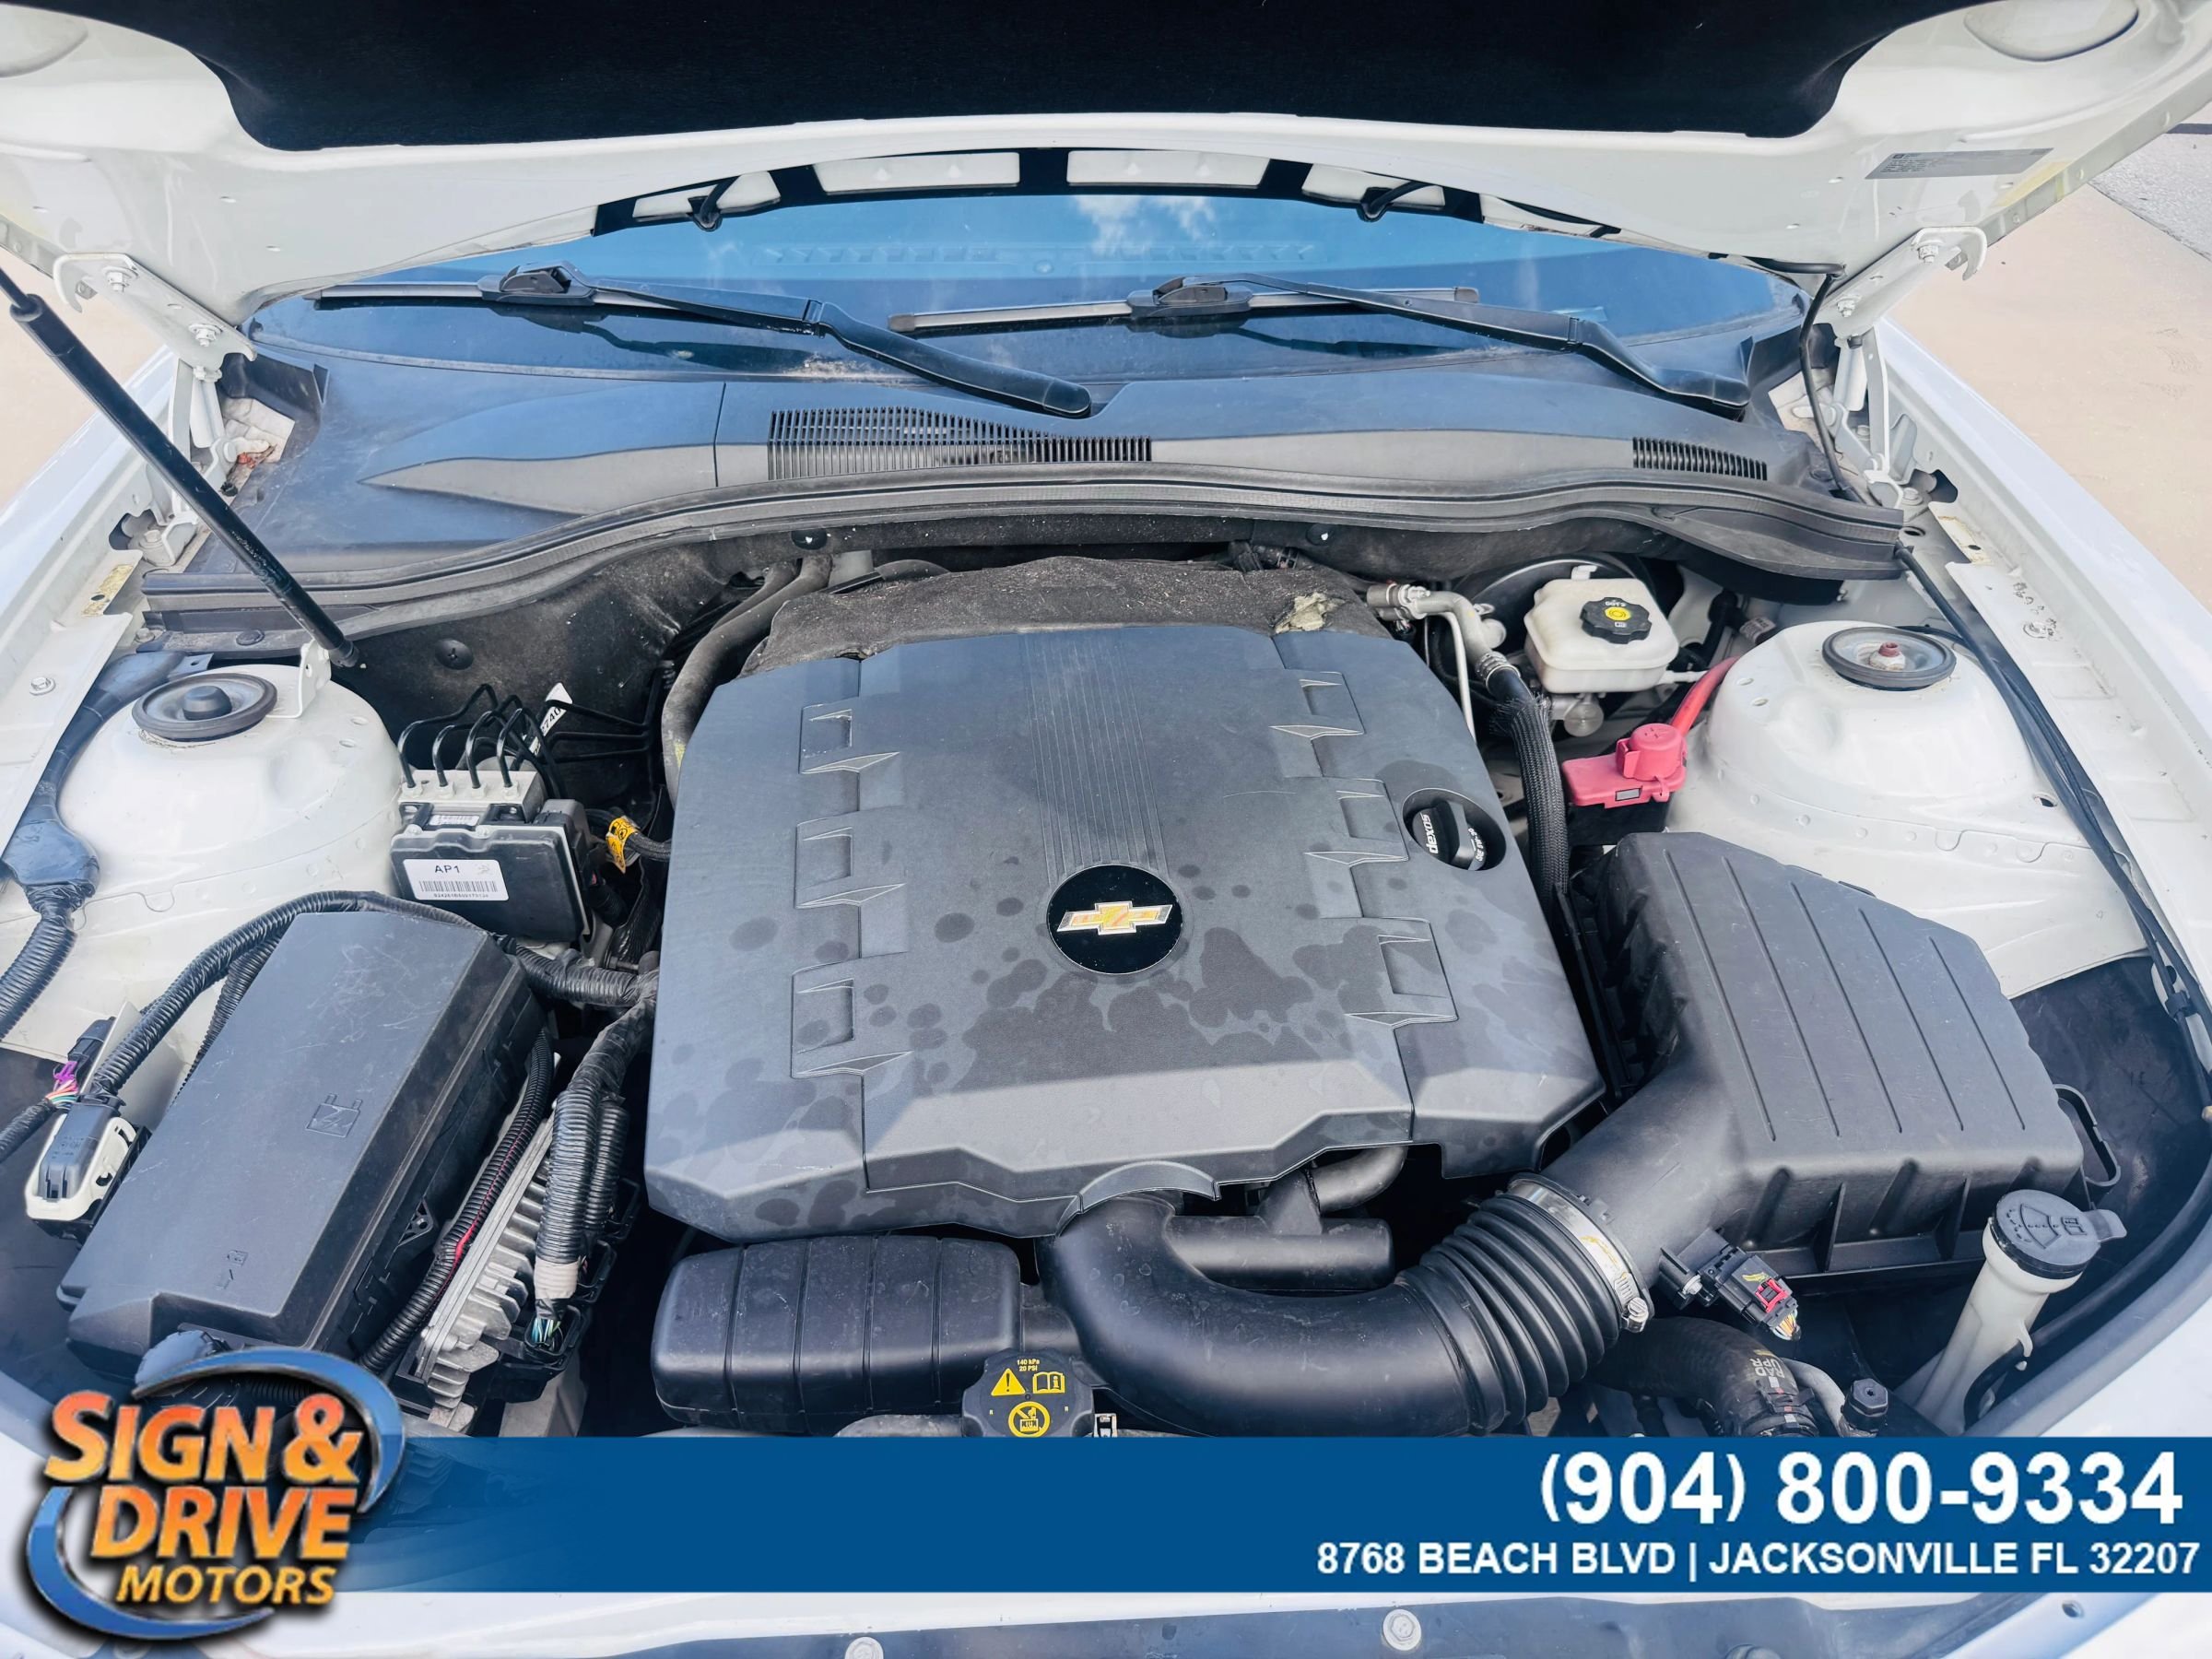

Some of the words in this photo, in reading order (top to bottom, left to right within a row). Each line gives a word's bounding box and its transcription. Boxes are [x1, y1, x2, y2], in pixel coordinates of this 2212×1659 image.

[1420, 812, 1439, 854] dexos
[434, 865, 460, 874] AP1
[1749, 1358, 1783, 1371] UPR
[1755, 1366, 1785, 1379] RAD
